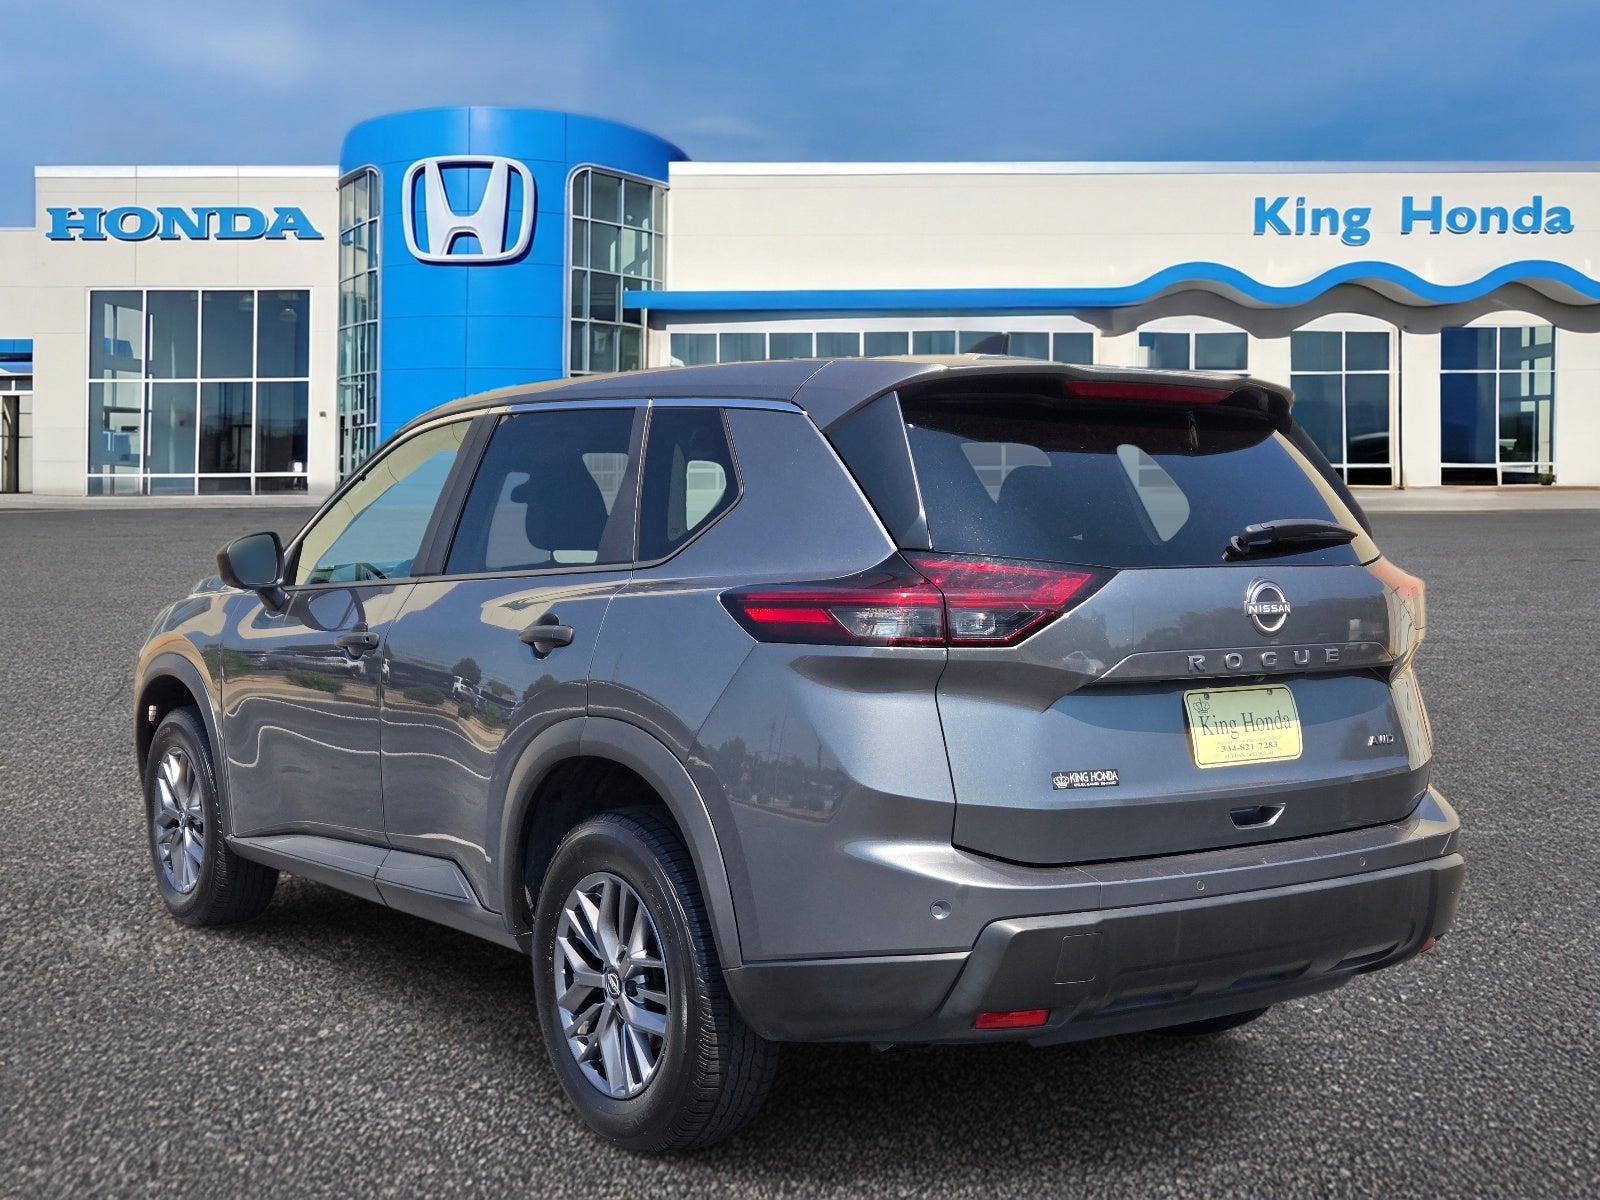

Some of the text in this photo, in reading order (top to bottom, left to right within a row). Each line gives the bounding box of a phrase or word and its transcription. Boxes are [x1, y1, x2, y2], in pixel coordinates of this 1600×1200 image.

[45, 205, 324, 241] HONDA
[1253, 195, 1575, 246] King Honda
[1248, 602, 1291, 614] NISSAN
[1187, 647, 1340, 672] ROGUE
[1199, 709, 1292, 740] King Honda
[1221, 741, 1278, 753] 334-821-7283
[1069, 770, 1118, 783] KING HONDA
